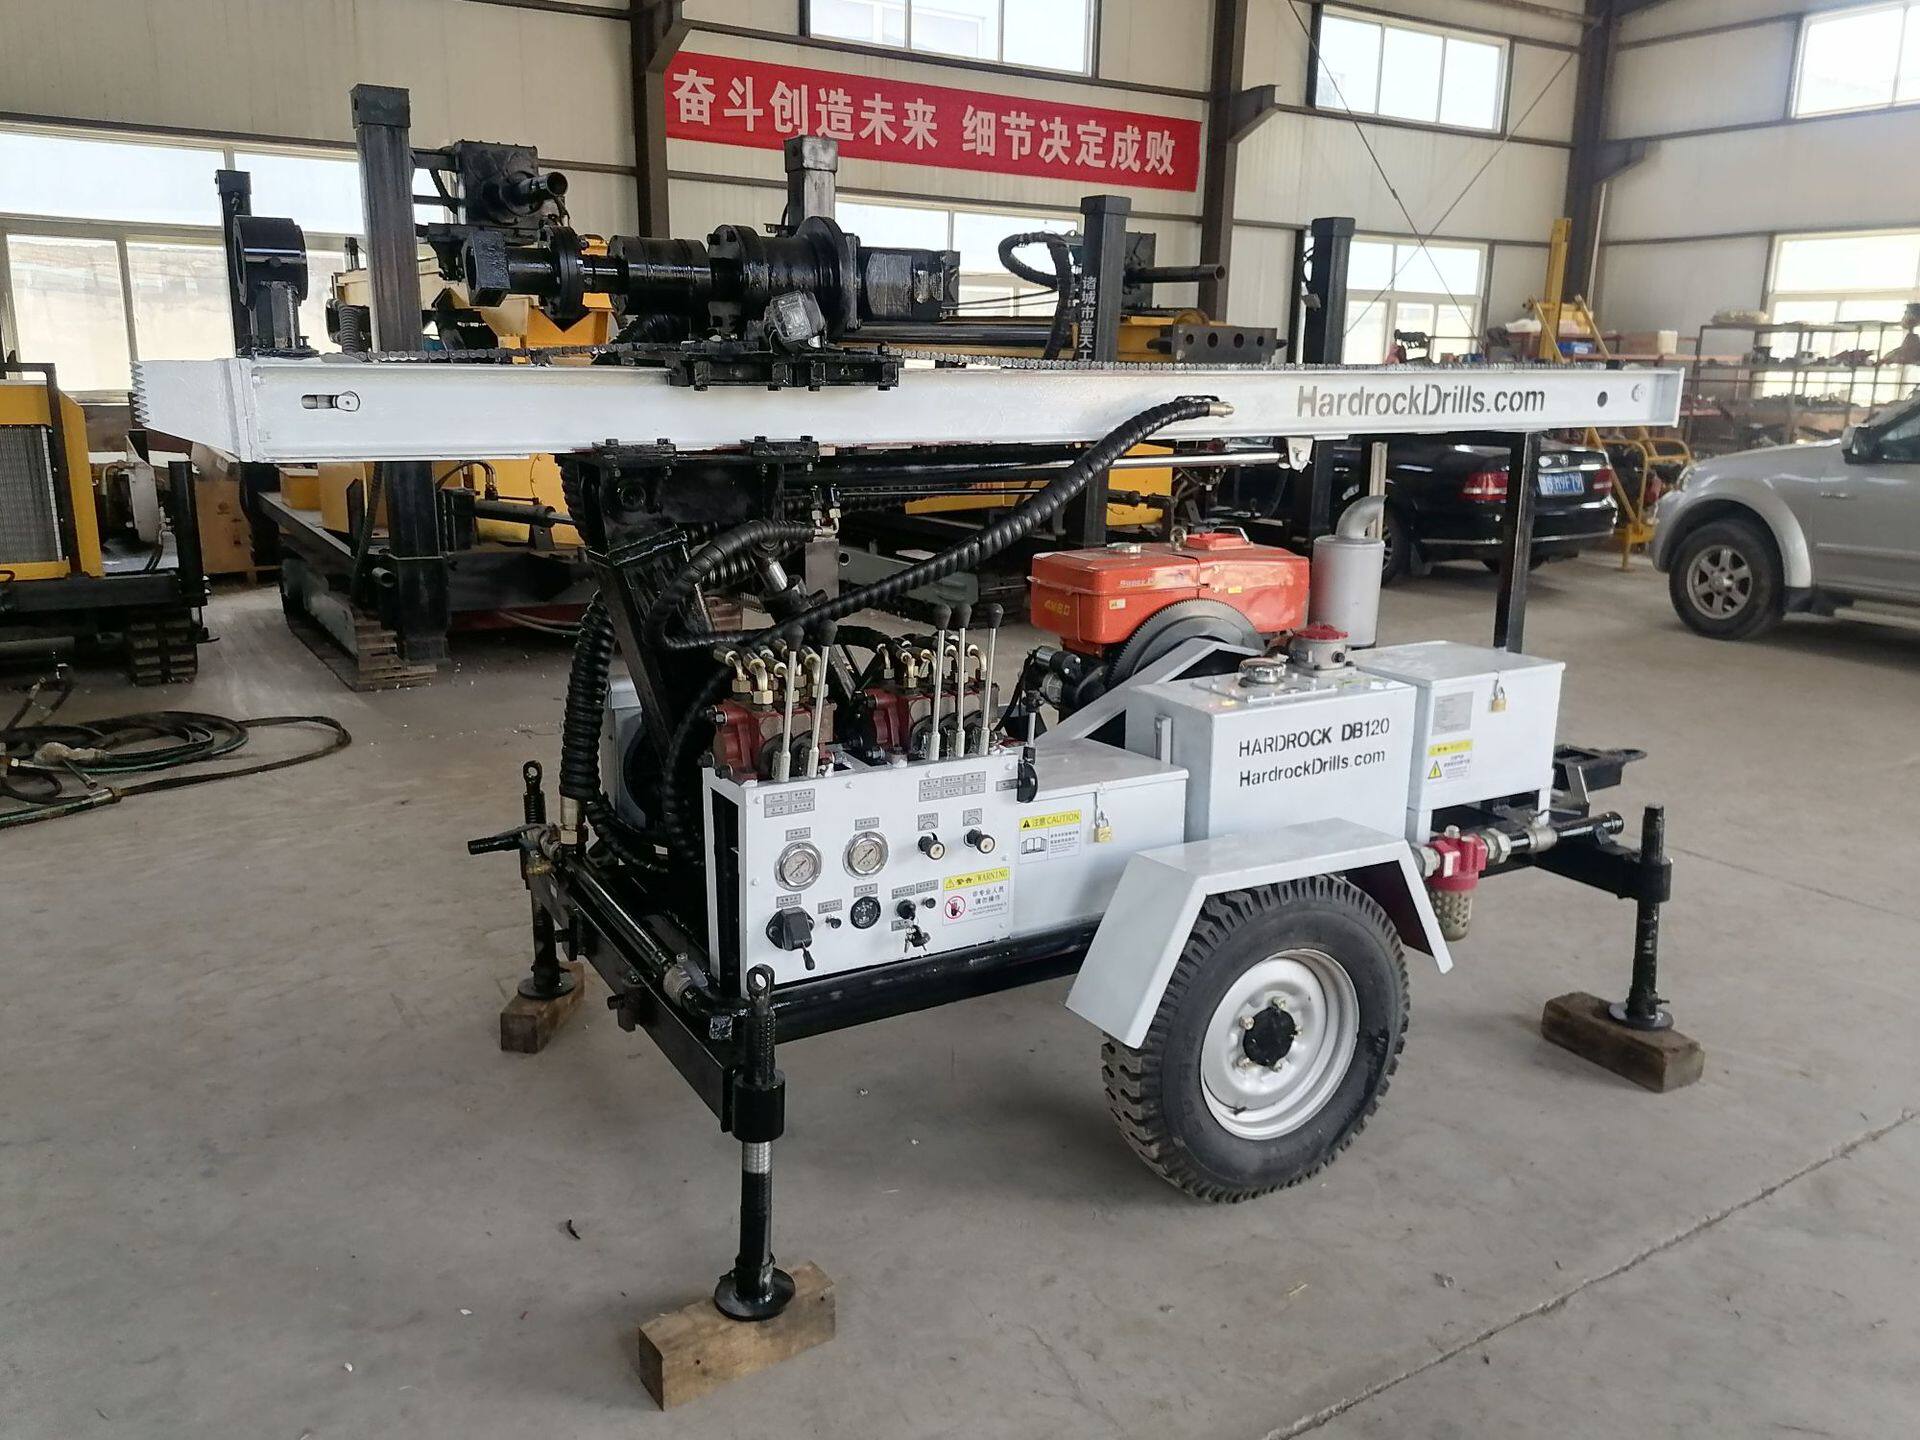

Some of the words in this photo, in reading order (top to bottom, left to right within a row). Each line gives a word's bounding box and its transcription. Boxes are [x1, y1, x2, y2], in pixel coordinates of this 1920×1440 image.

[672, 68, 938, 150] 奋斗创造未来
[962, 104, 1176, 176] 细节决定成败
[1297, 384, 1545, 417] HardrockDrills.com
[1238, 726, 1333, 757] HARDROCK
[1341, 717, 1390, 742] DB120
[1239, 750, 1386, 787] HardrockDrills.com
[1046, 813, 1079, 825] CAUTION
[977, 869, 1008, 881] WARNING
